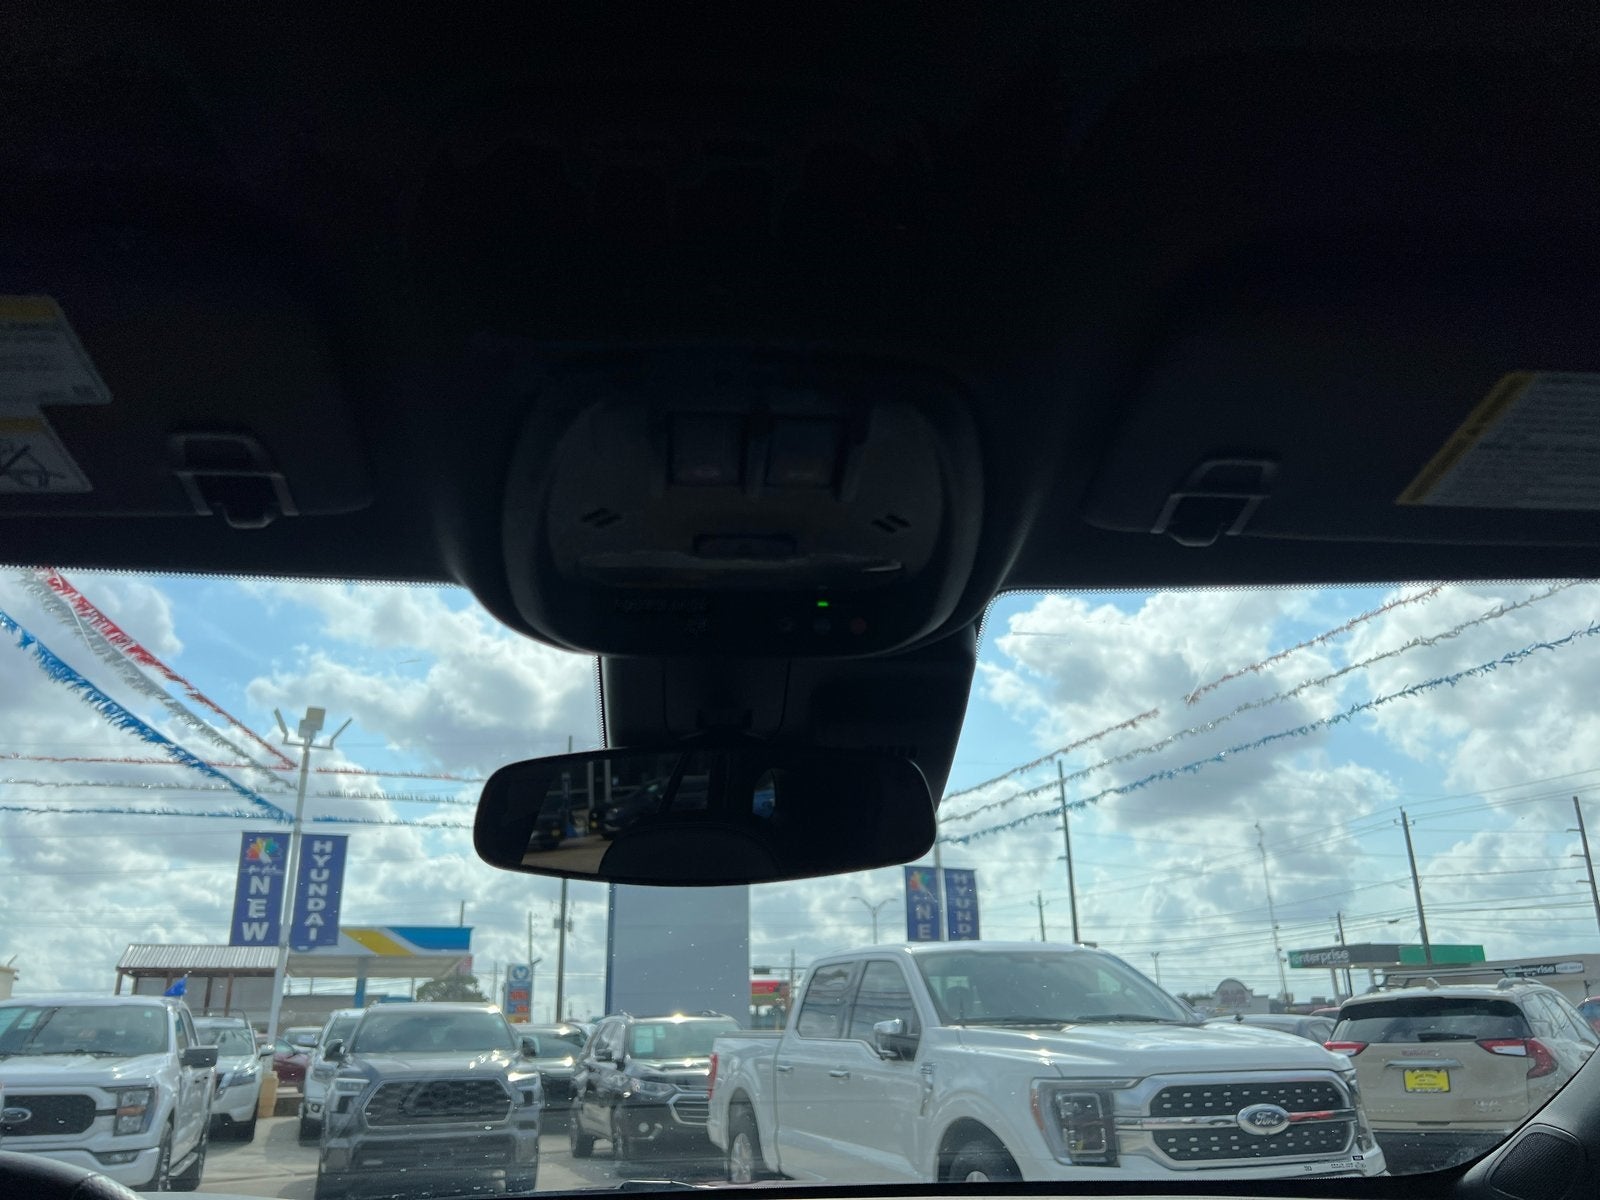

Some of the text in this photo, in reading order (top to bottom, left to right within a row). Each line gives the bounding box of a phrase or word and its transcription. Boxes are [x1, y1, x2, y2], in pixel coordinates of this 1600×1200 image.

[241, 876, 270, 942] NEW
[304, 840, 332, 941] HYUNDAI
[1255, 1111, 1279, 1125] Ford
